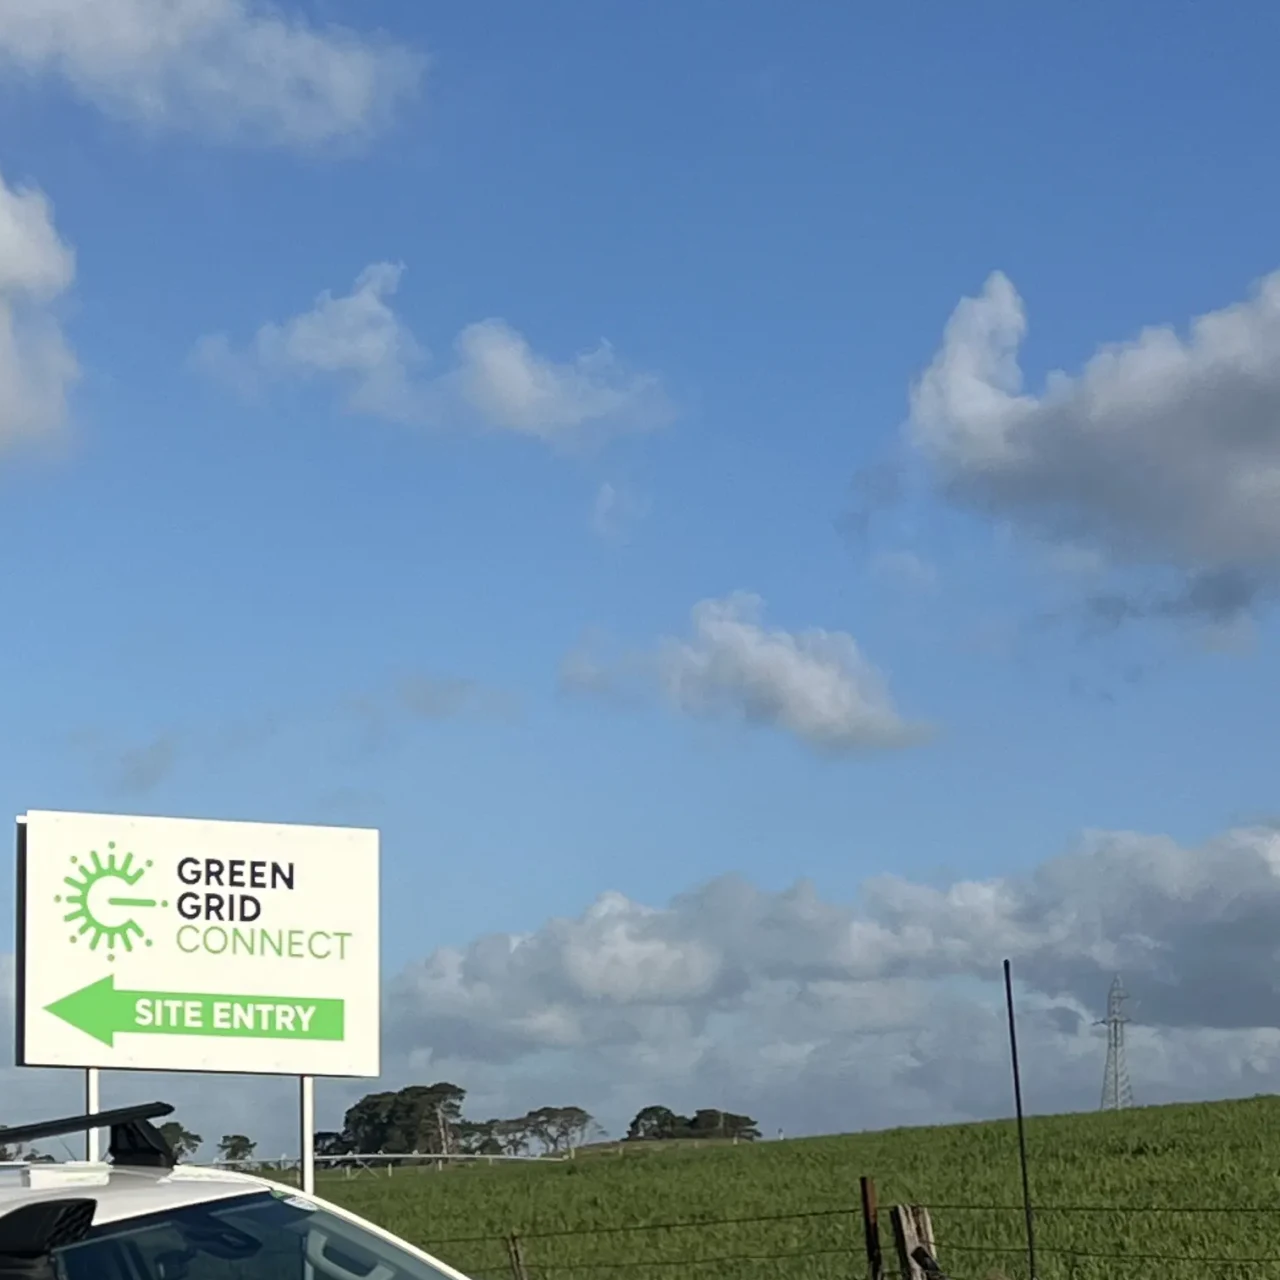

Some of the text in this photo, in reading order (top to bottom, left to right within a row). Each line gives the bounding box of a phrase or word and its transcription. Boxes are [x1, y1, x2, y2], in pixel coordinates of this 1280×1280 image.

[176, 856, 295, 890] GREEN
[176, 891, 262, 922] GRID
[176, 925, 353, 960] CONNECT
[134, 998, 317, 1032] SITE ENTRY
